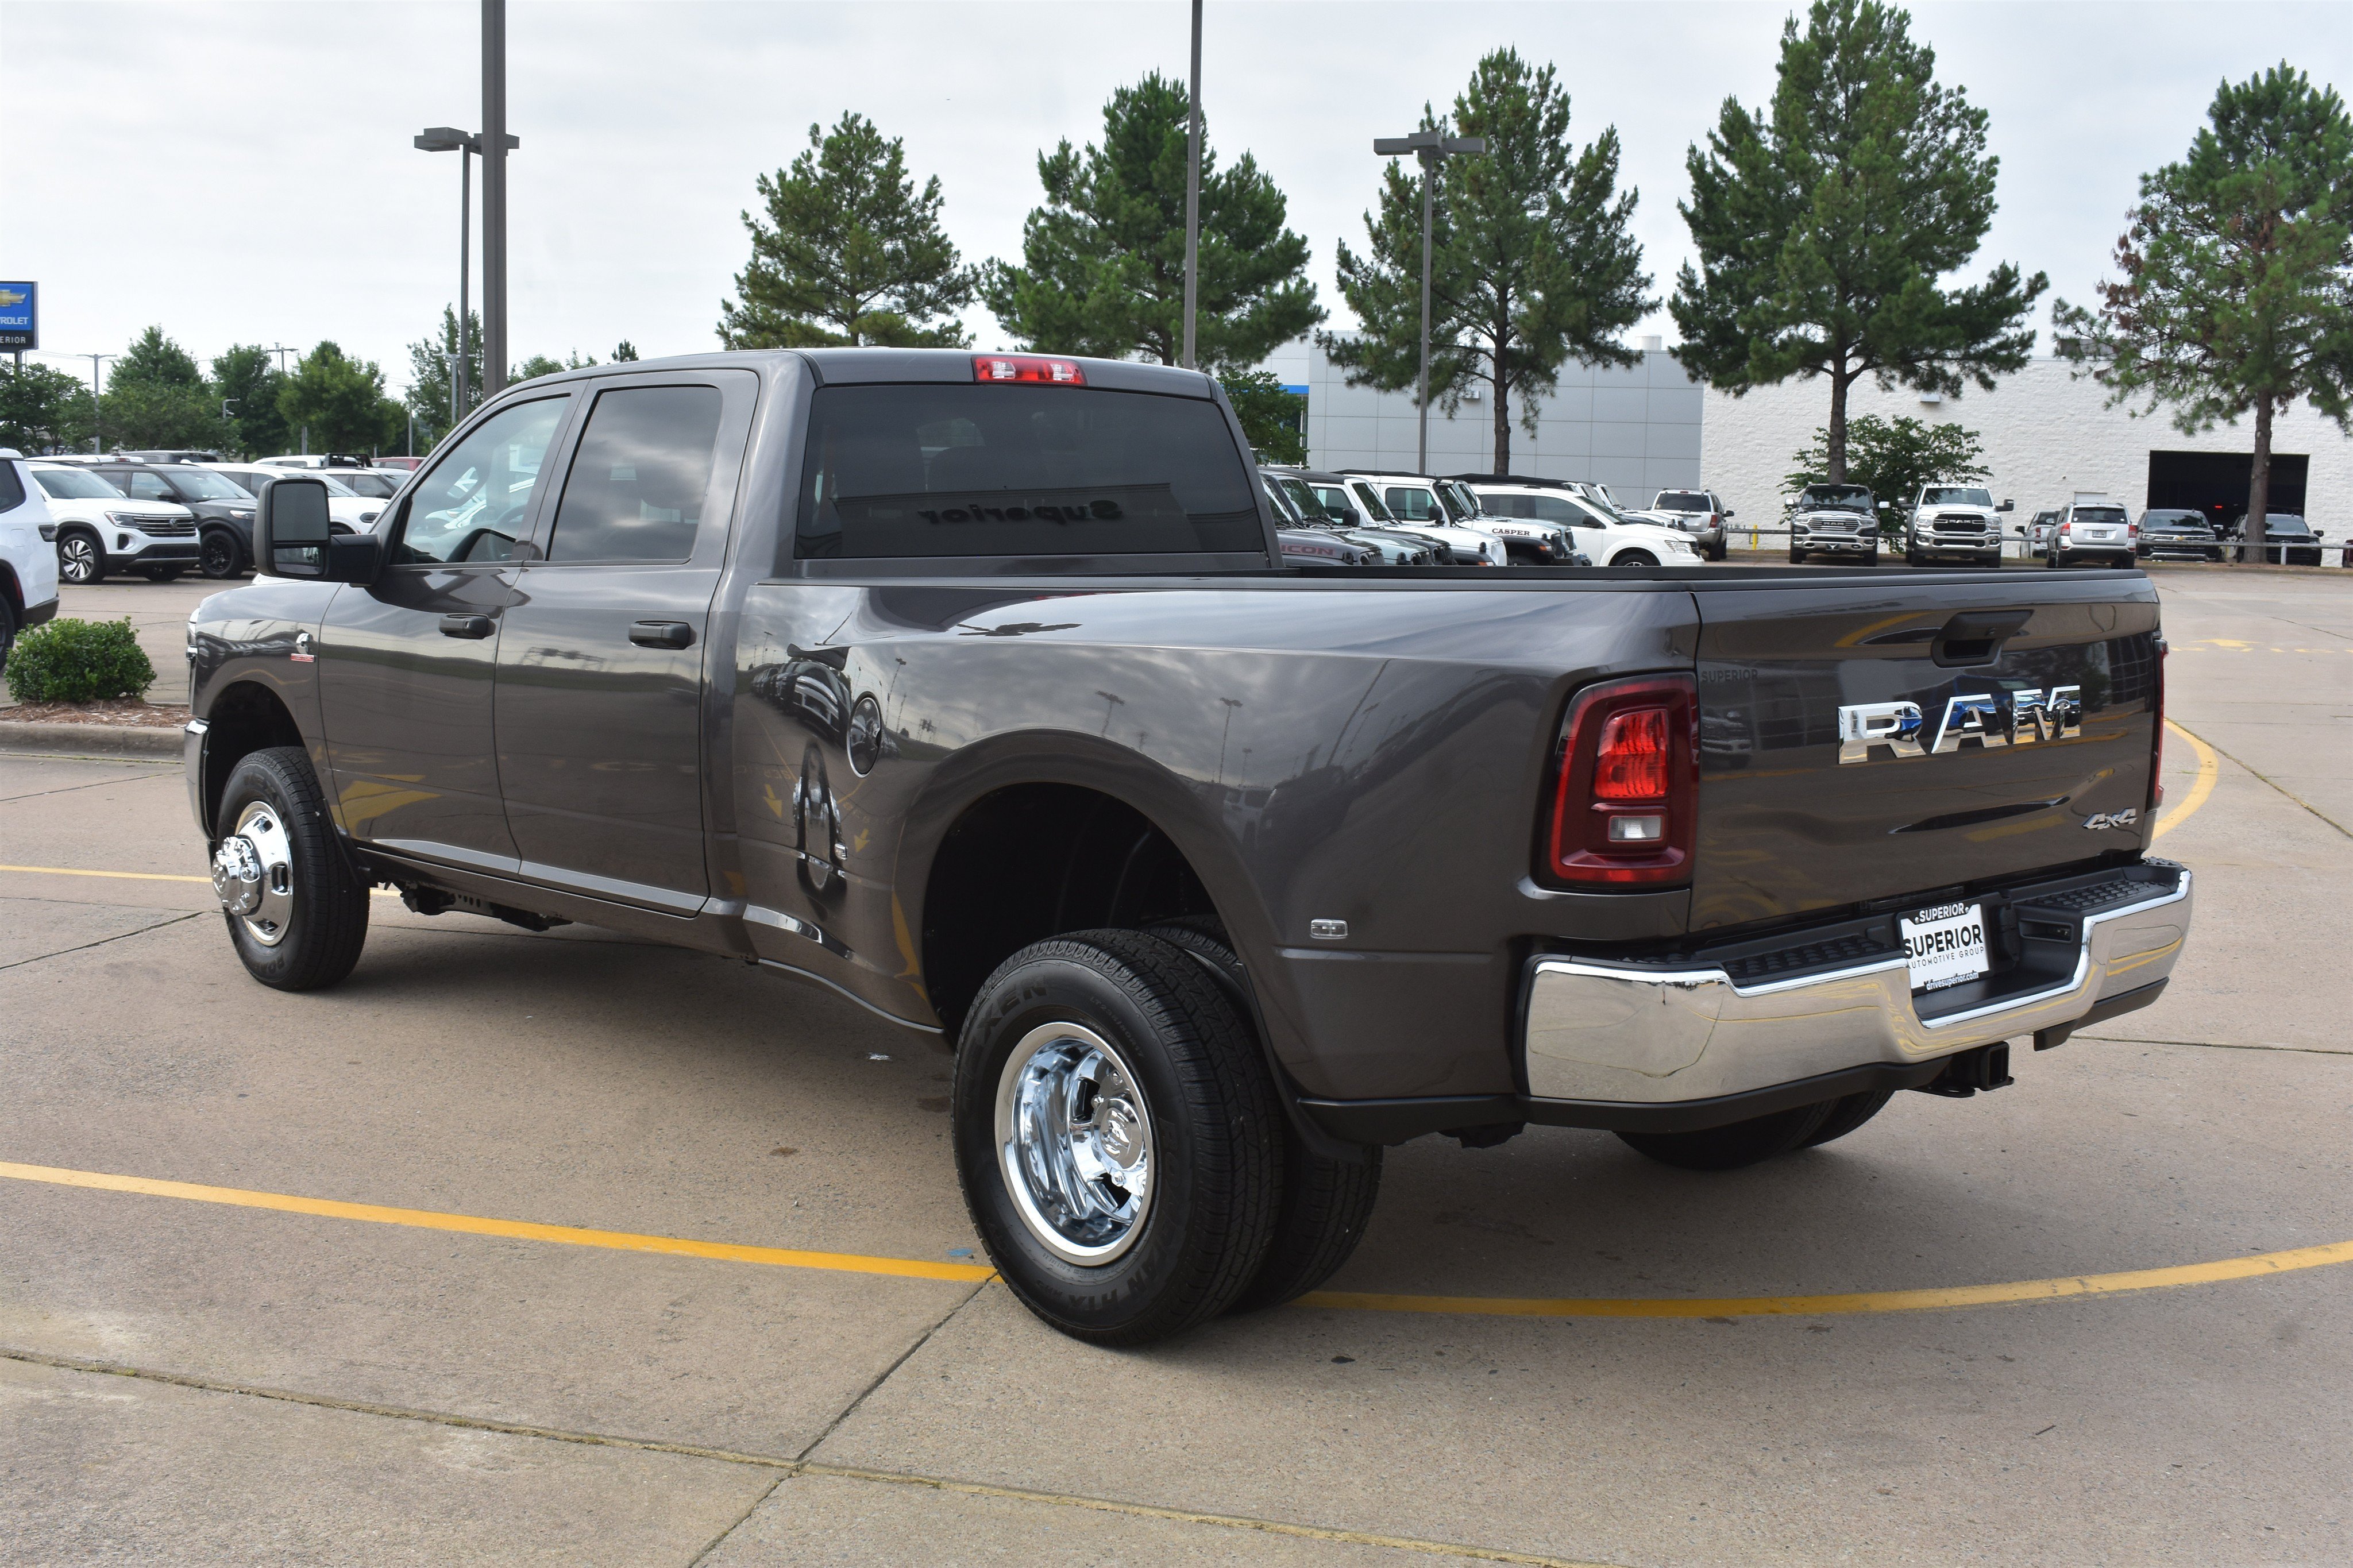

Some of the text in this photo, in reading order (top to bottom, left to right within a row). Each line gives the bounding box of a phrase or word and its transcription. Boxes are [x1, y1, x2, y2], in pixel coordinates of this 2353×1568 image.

[0, 316, 28, 325] ROLET
[1492, 528, 1530, 536] CASPER
[1280, 544, 1335, 556] ICON
[1701, 669, 1758, 682] SUPERIOR
[1838, 685, 2080, 764] RAM
[1919, 902, 1965, 922] SUPERIOR
[1903, 924, 1983, 960] SUPERIOR
[1959, 946, 1984, 958] GROUP
[1926, 971, 1979, 990] drivesuperior.com
